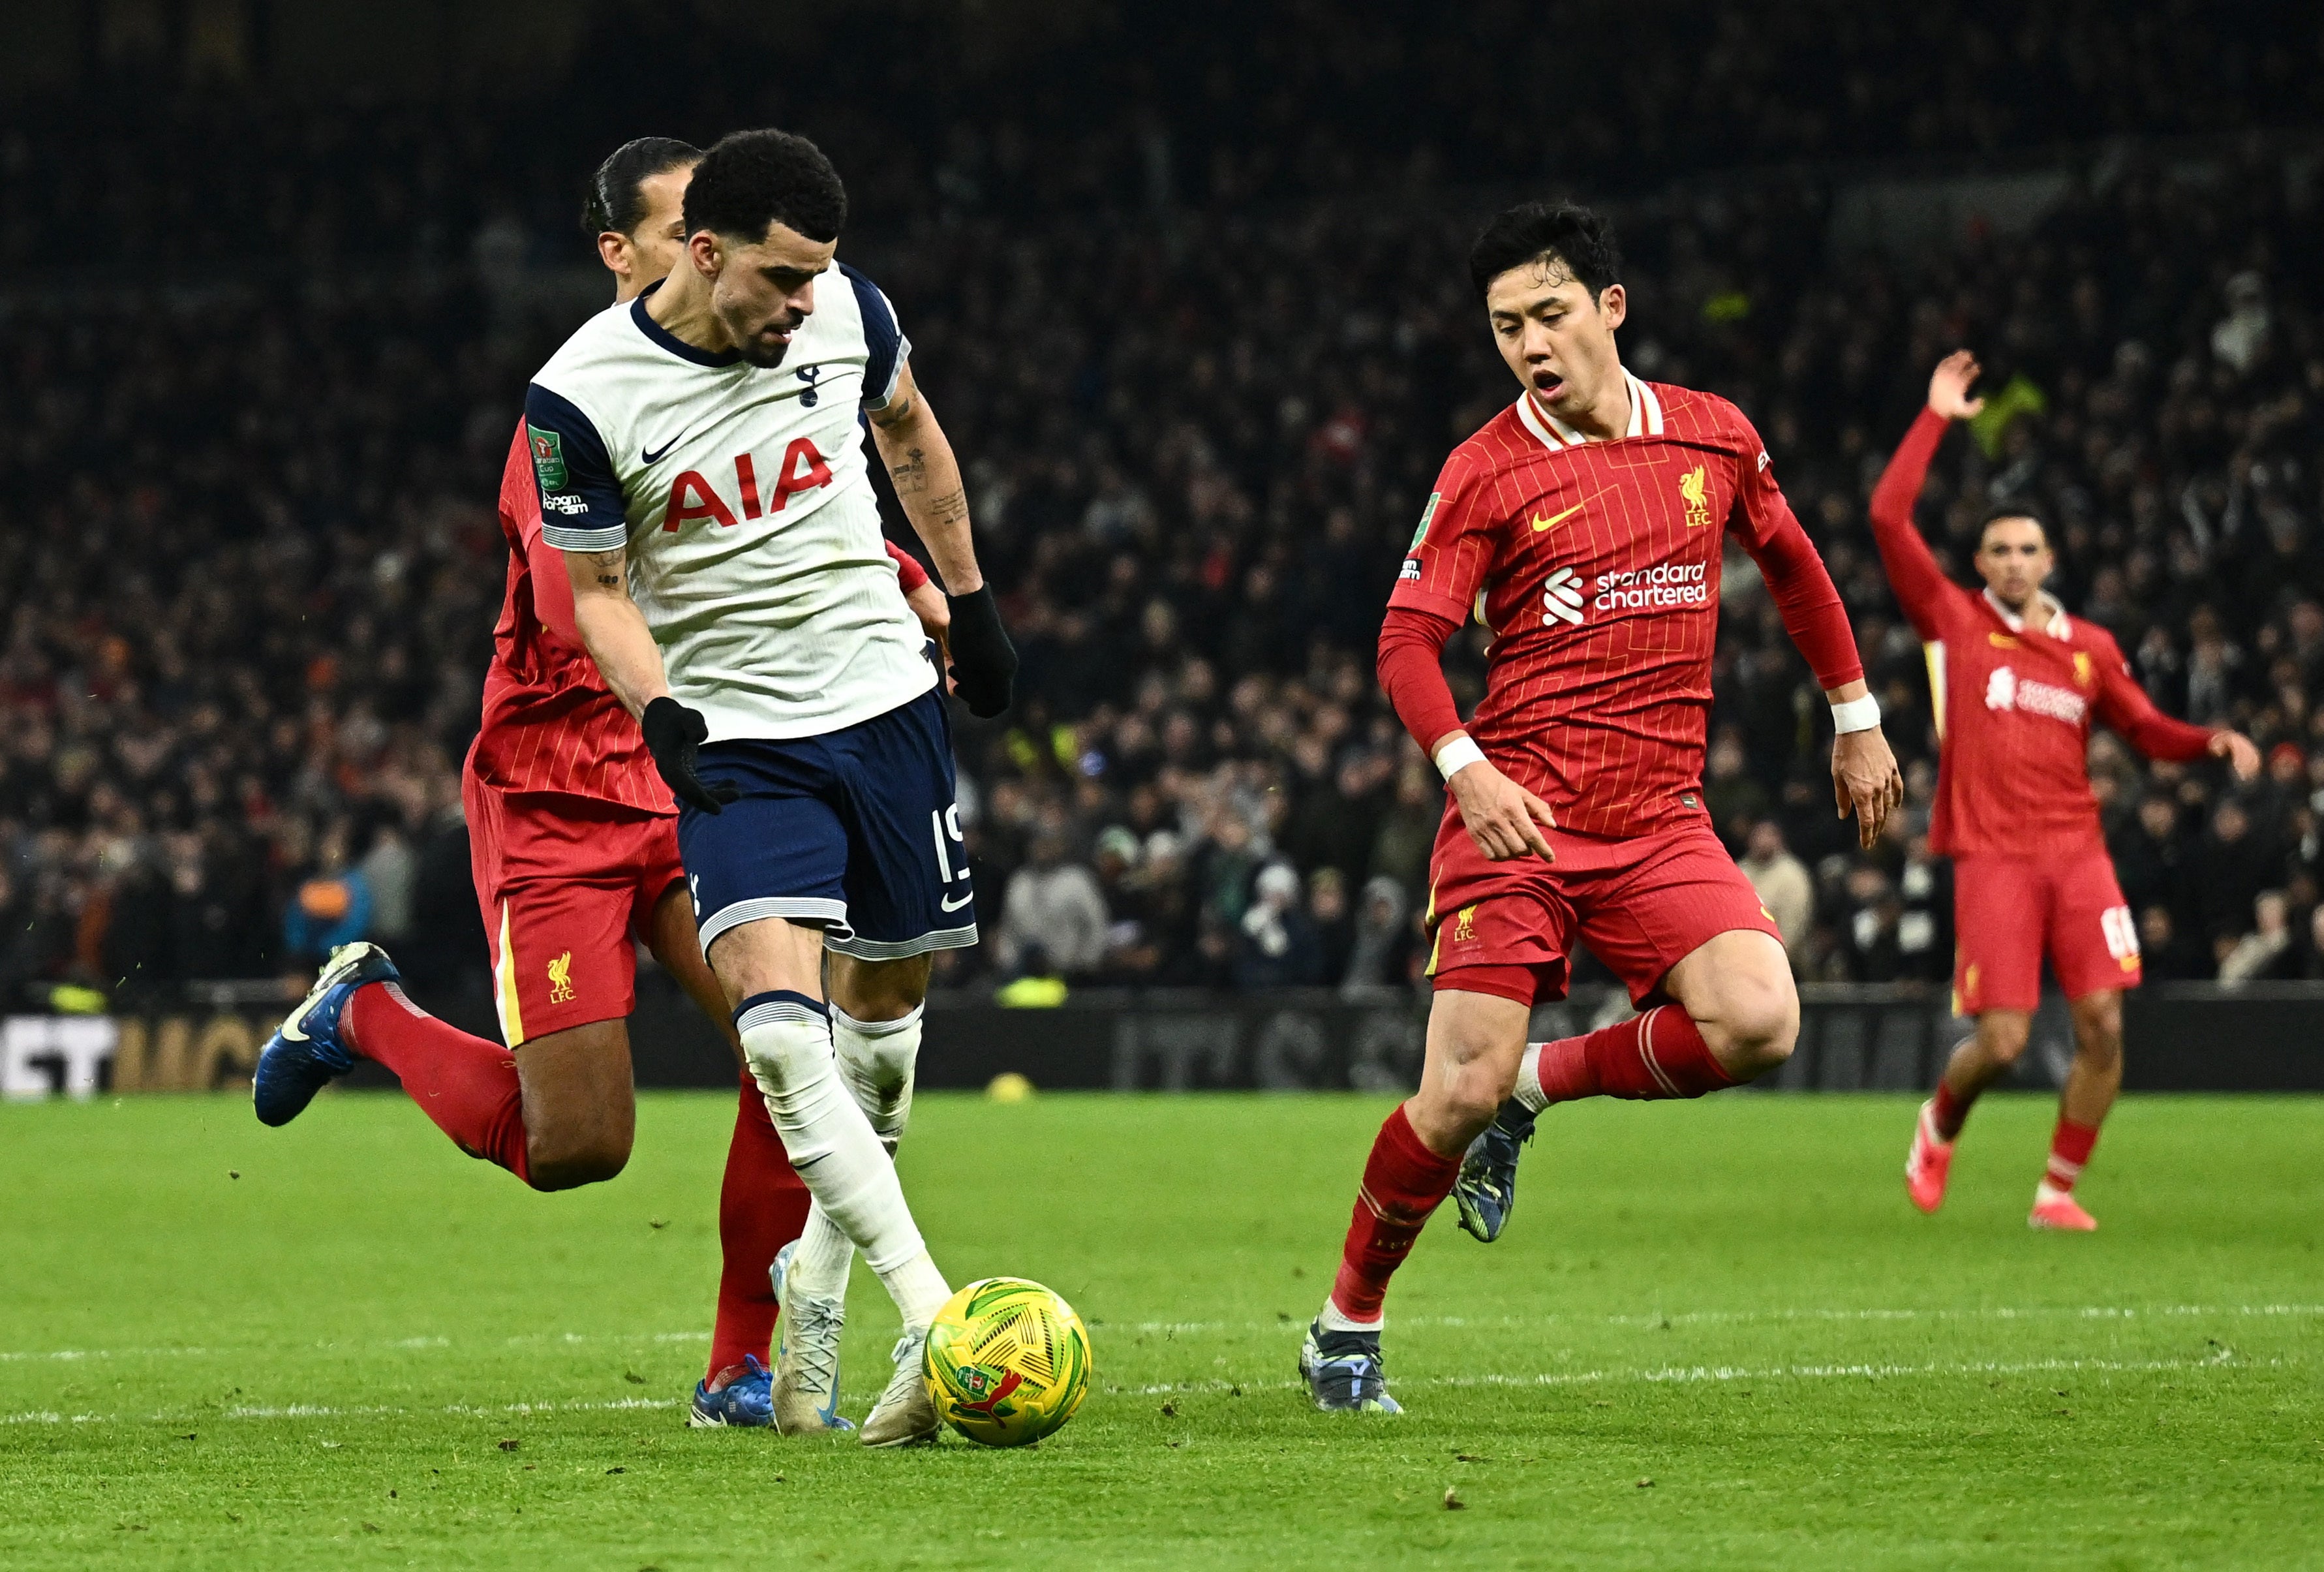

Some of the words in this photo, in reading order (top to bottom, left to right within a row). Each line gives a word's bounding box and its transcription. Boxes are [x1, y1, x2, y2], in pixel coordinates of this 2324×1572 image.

[662, 437, 833, 533] AIA
[1597, 559, 1707, 593] standard
[1595, 580, 1707, 610] chartered
